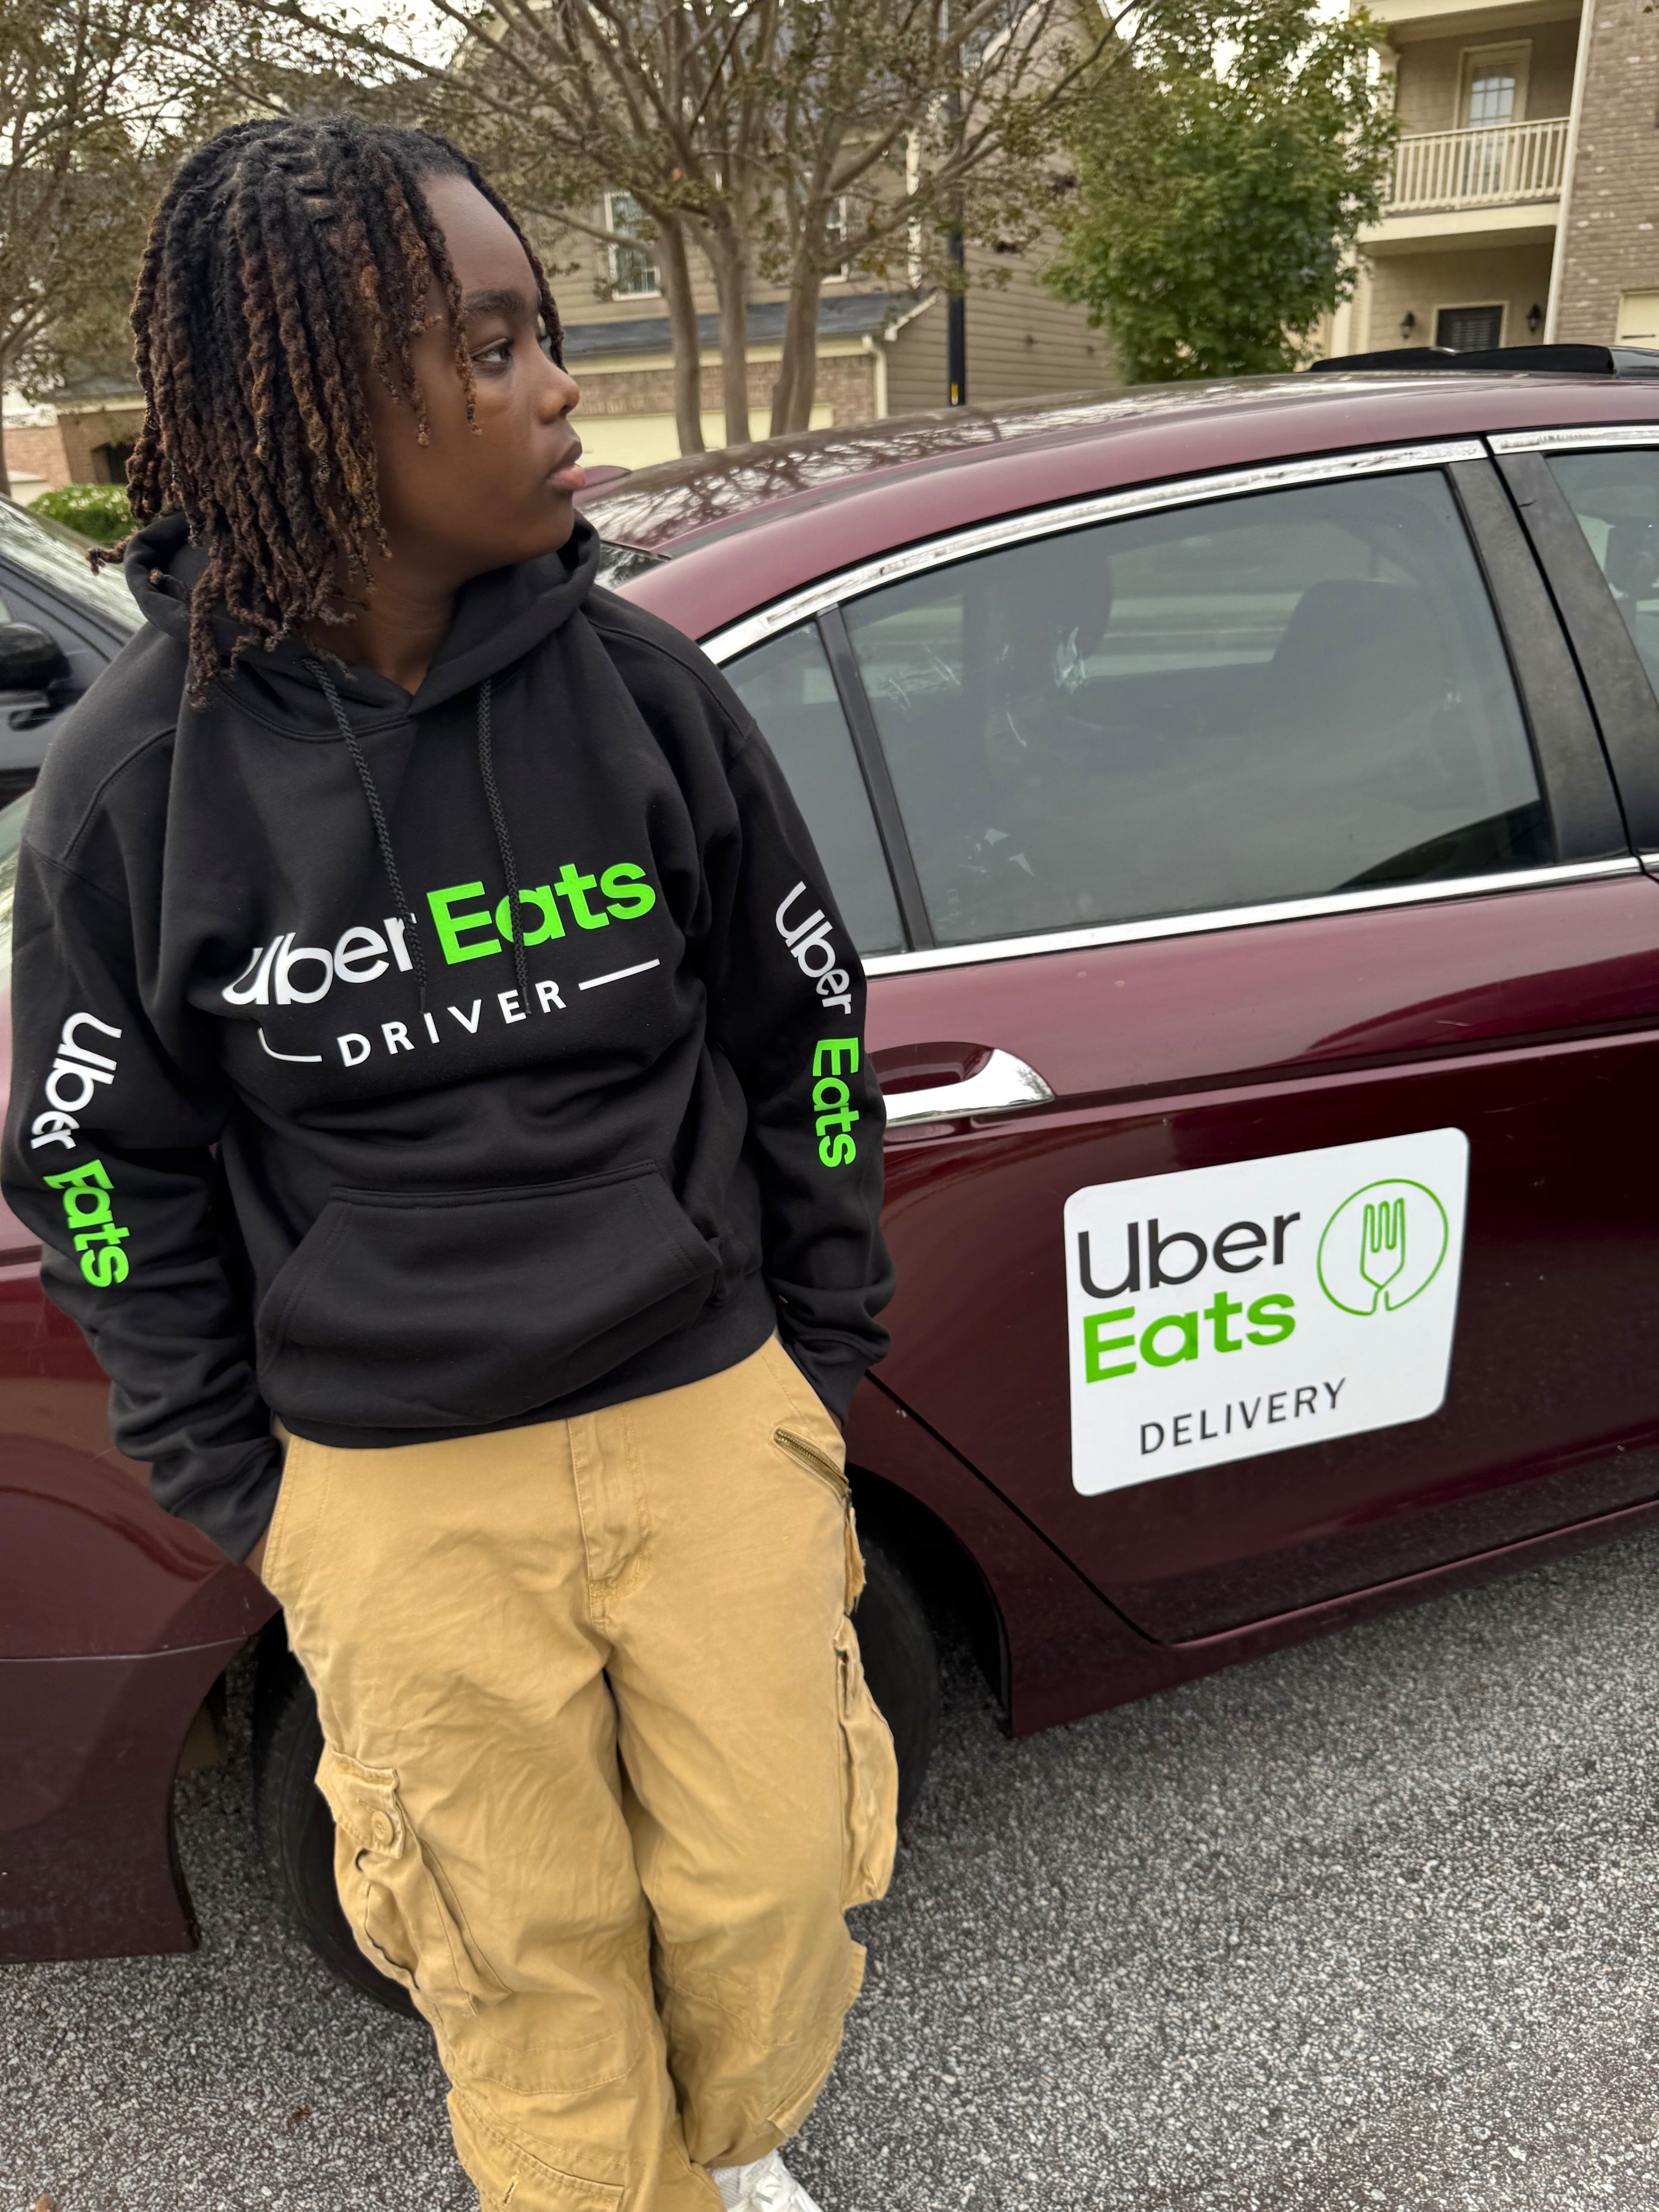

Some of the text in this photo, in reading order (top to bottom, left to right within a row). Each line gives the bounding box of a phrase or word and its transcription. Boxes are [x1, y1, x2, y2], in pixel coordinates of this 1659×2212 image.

[221, 863, 656, 1005] Uber Eats
[336, 980, 567, 1067] DRIVER
[775, 881, 859, 1167] Uber Eats
[30, 1012, 130, 1288] Uber Eats
[1077, 1211, 1301, 1299] Uber
[1083, 1291, 1296, 1384] Eats
[1141, 1377, 1347, 1455] DELIVERY
